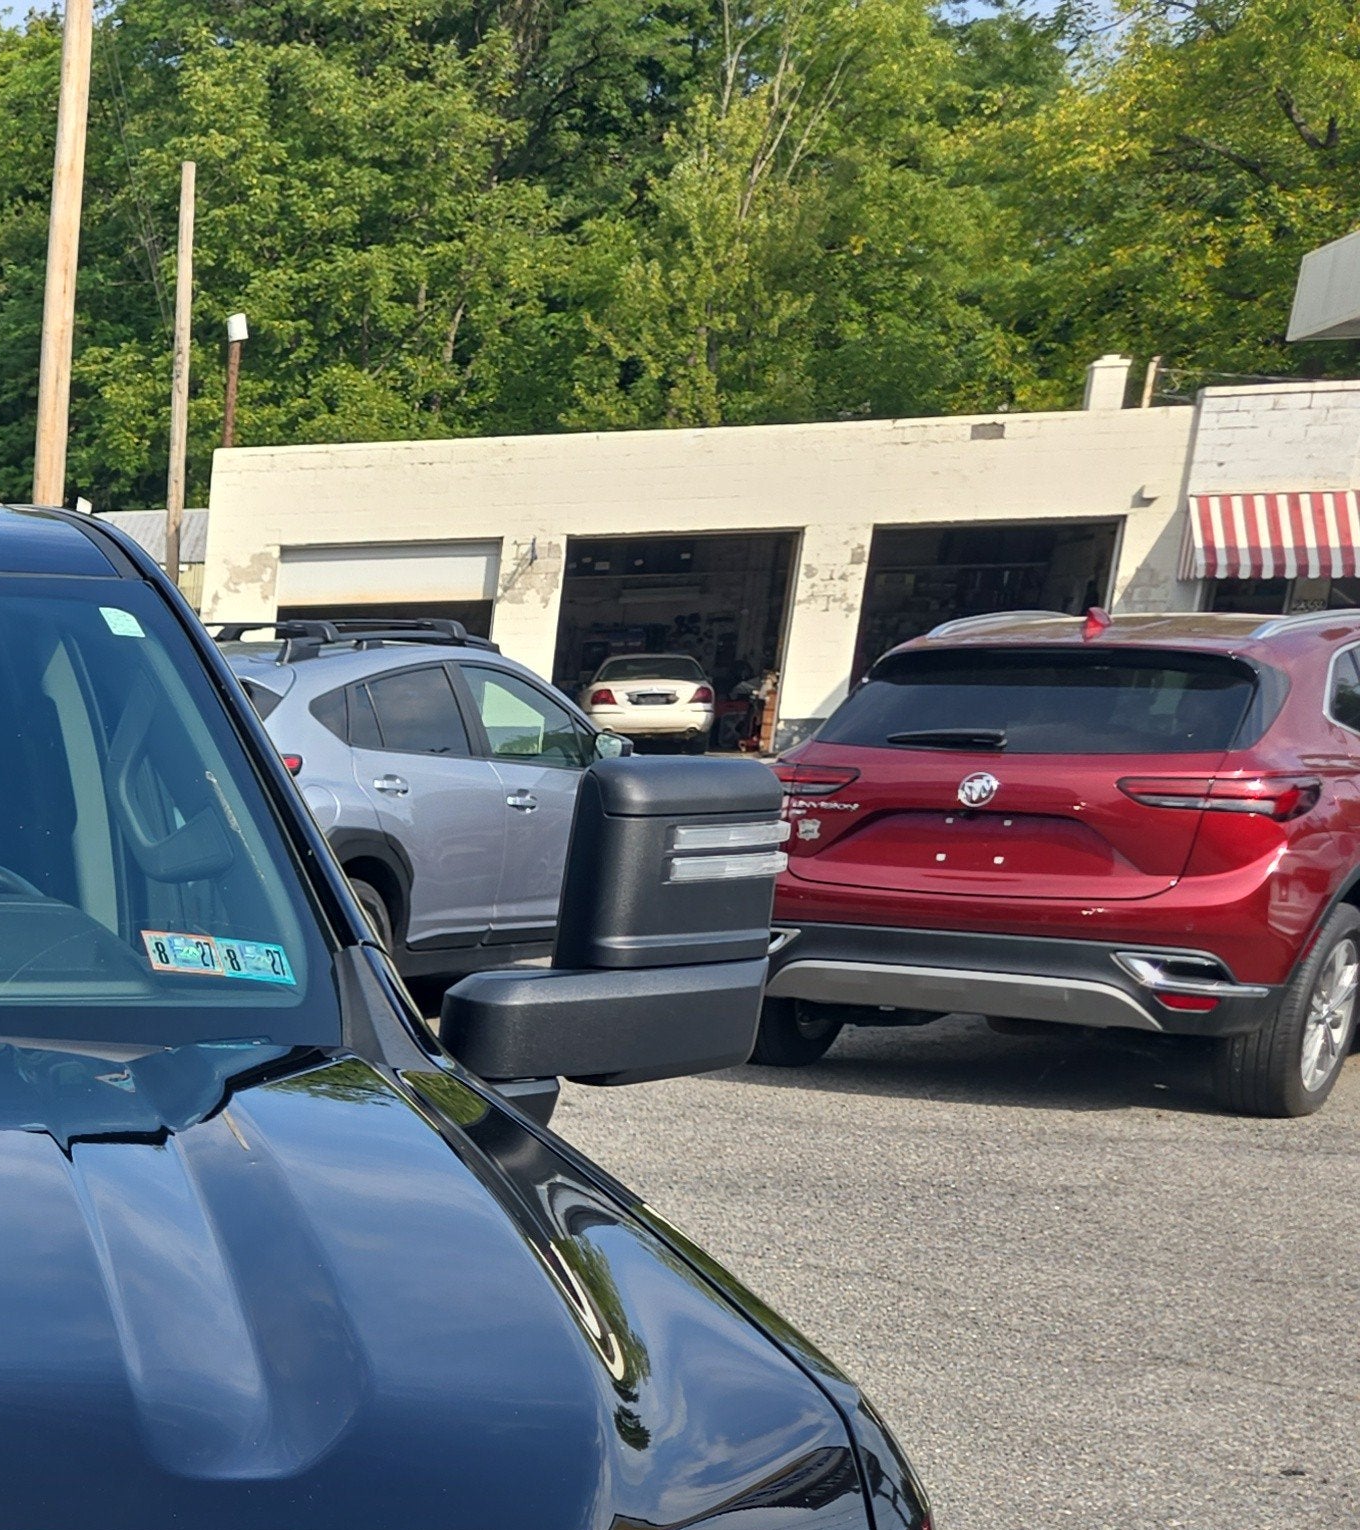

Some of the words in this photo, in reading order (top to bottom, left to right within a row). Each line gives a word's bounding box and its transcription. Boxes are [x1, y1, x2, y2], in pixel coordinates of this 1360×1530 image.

[154, 941, 170, 965] 8
[195, 941, 216, 970] 27
[226, 949, 242, 972] 8
[265, 950, 286, 976] 27
